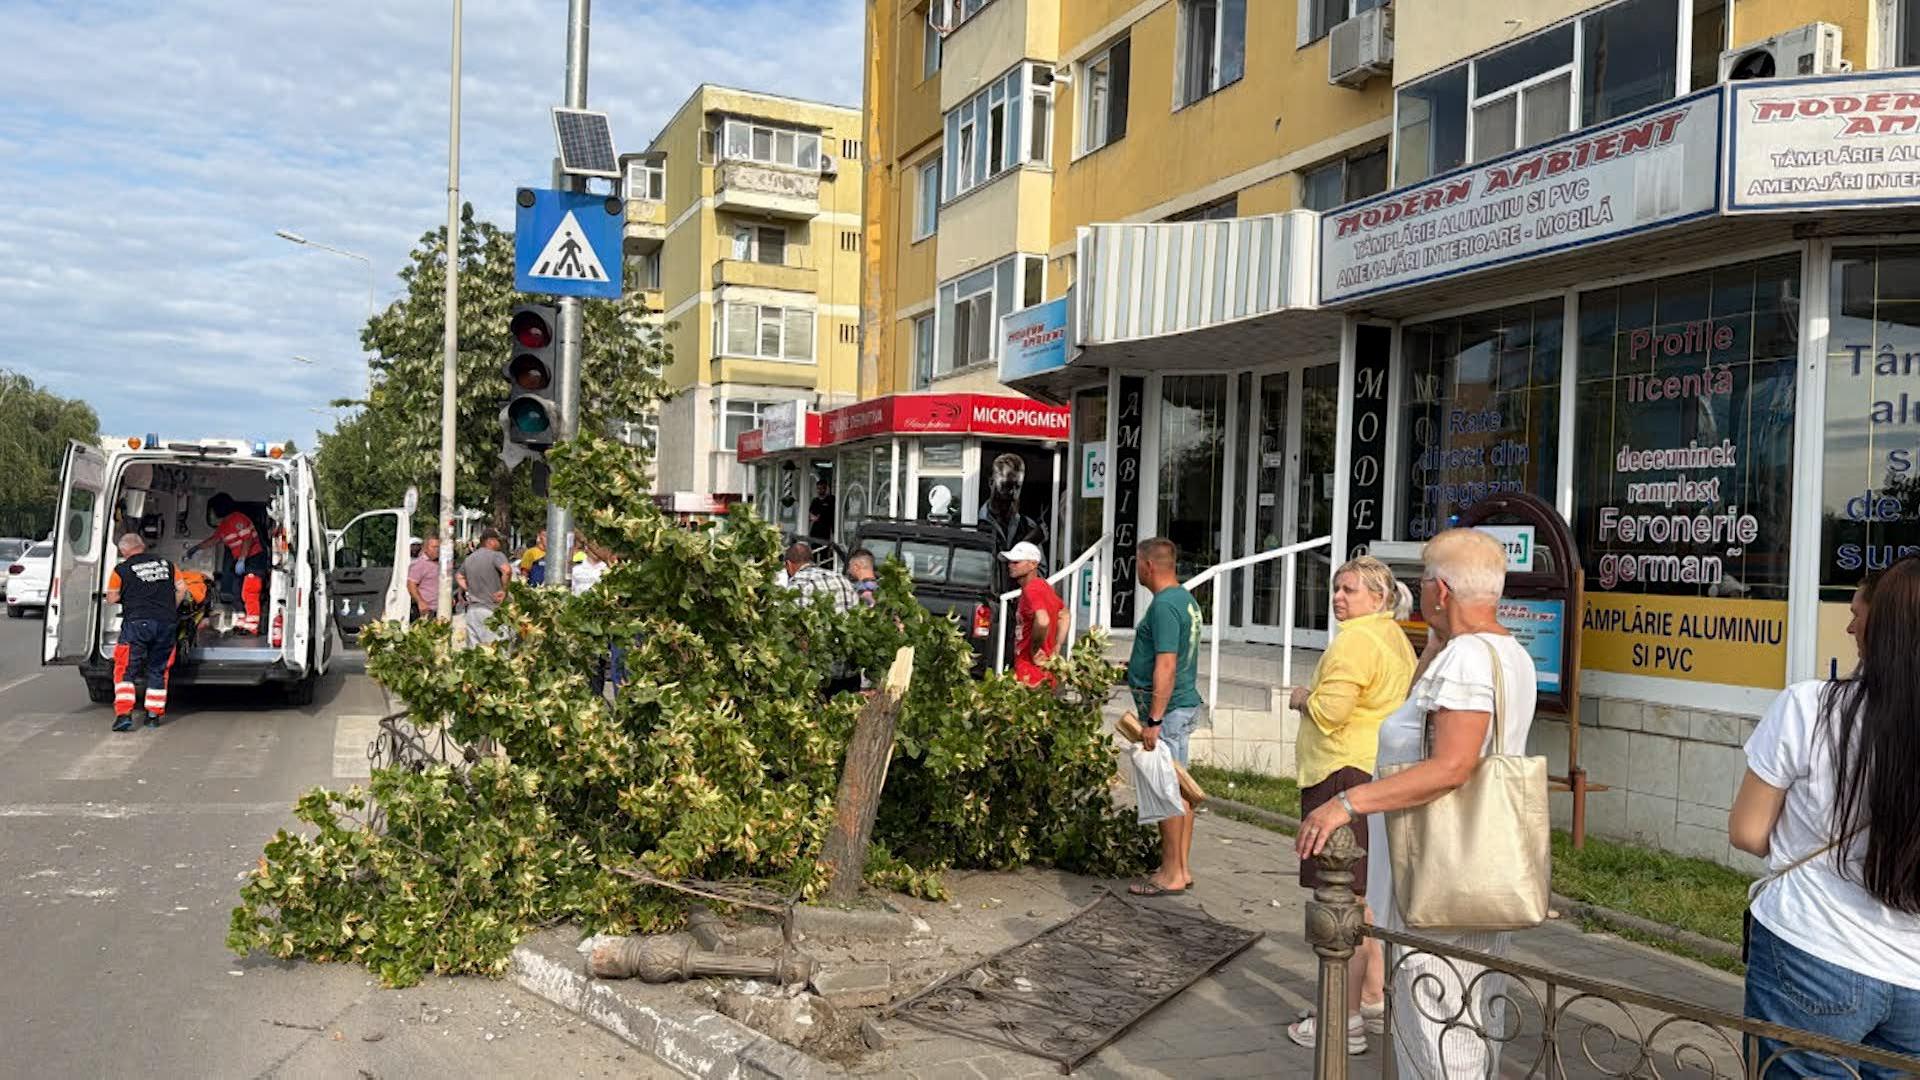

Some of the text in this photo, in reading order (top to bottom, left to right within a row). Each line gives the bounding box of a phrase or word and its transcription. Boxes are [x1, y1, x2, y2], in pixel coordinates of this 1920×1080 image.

[1337, 108, 1688, 238] MODERN AMBIENT
[1437, 195, 1522, 238] ALUMINIU
[1526, 190, 1546, 214] SI
[1548, 178, 1589, 208] PVC
[1423, 223, 1521, 269] INTERIOARE
[1630, 320, 1734, 360] Profile
[1450, 409, 1503, 433] Rate
[1490, 440, 1529, 466] din
[1617, 438, 1736, 472] deceuninck
[1112, 391, 1142, 616] AMBIENT
[1628, 473, 1720, 508] ramplast
[1847, 490, 1901, 522] de
[1599, 504, 1759, 544] Feronerie
[1679, 614, 1782, 645] ALUMINIU
[1632, 643, 1693, 672] SI PVC
